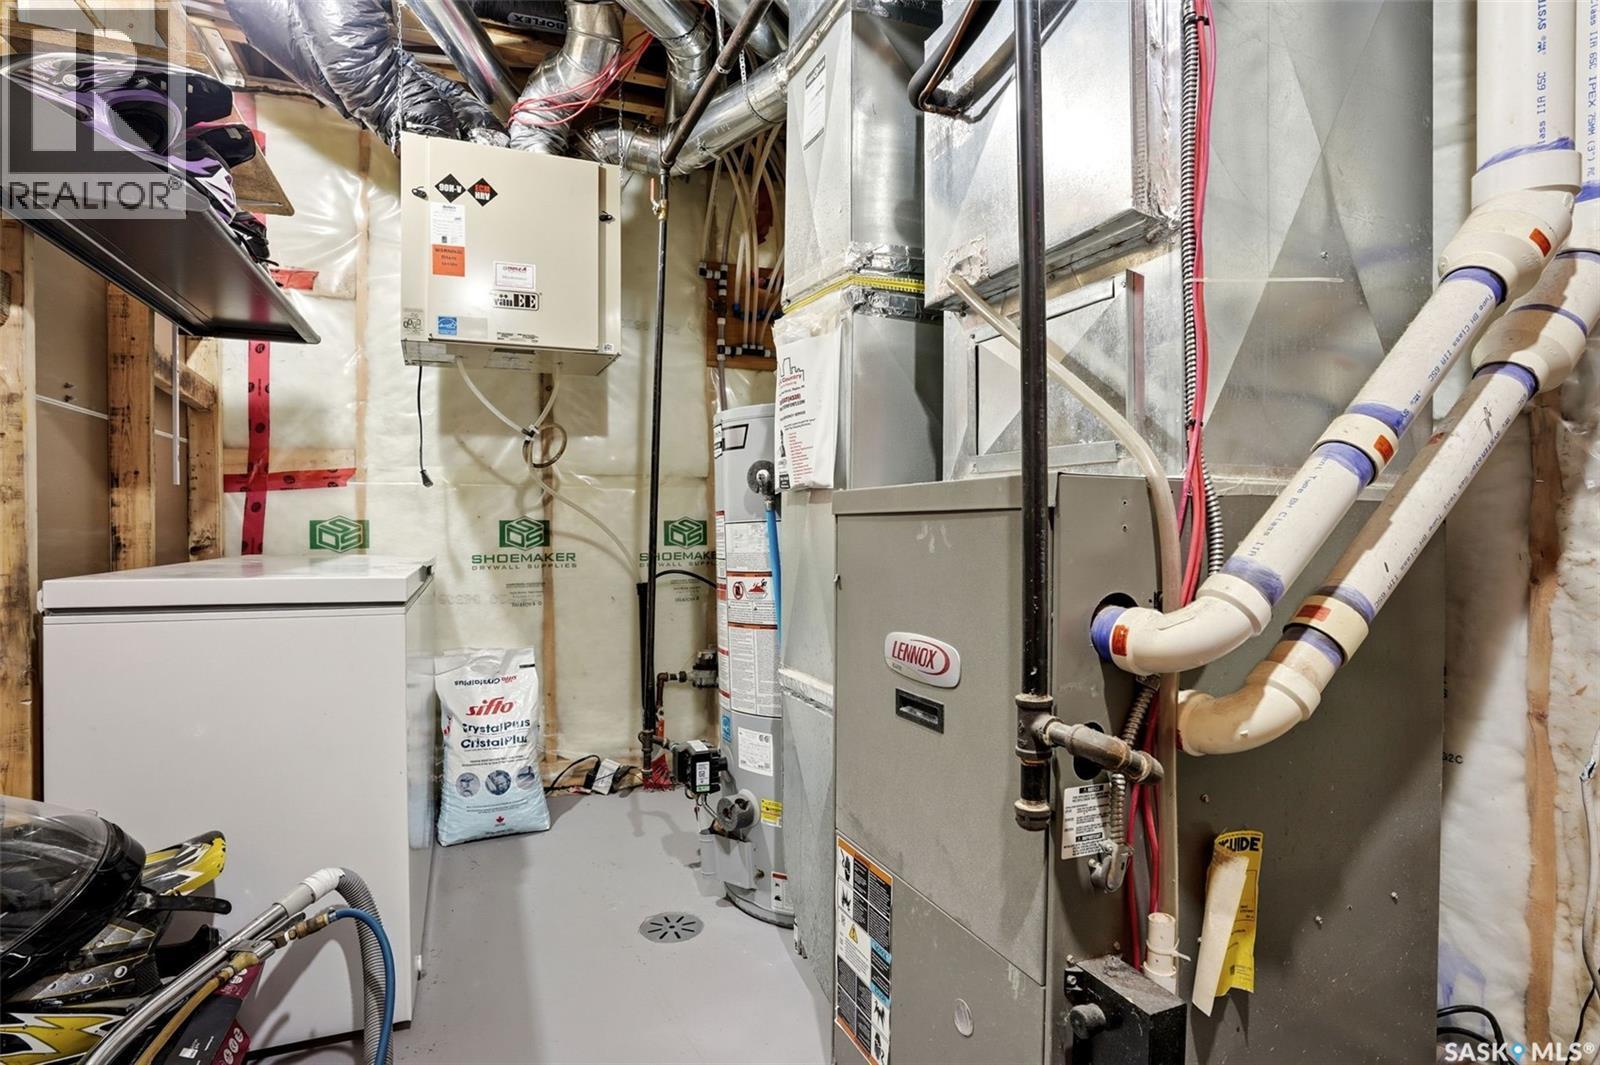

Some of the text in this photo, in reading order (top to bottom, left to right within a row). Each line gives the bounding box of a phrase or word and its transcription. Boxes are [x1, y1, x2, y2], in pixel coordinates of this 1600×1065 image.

[1537, 120, 1546, 143] lass
[471, 552, 576, 564] SHOEMAKER
[527, 562, 577, 570] SUPPLIES
[892, 640, 937, 670] LENNOX
